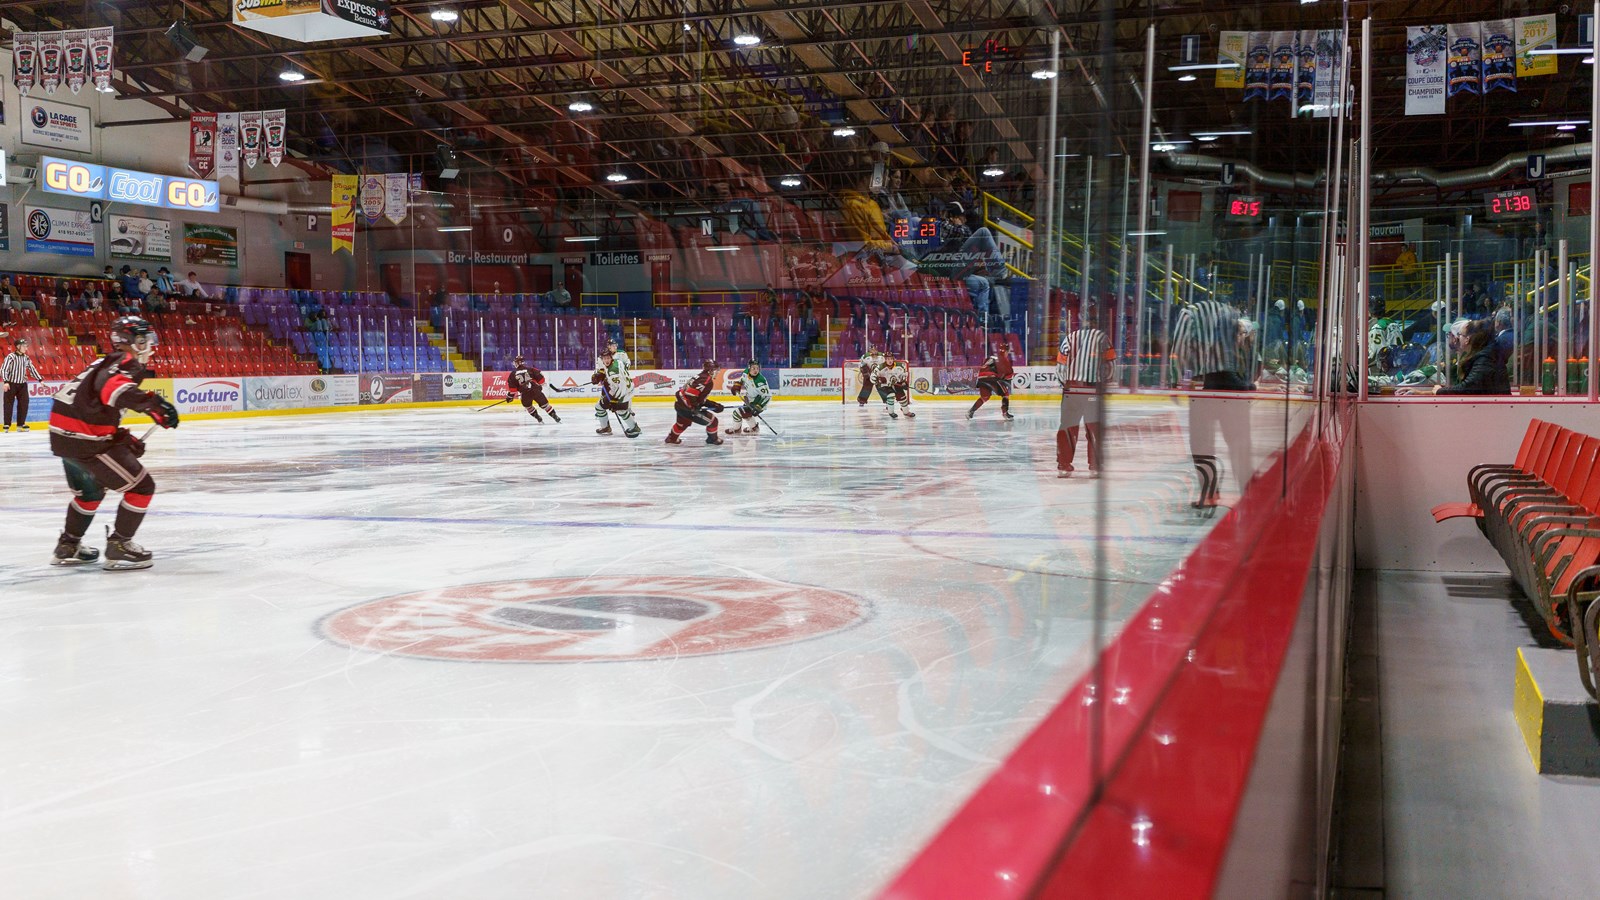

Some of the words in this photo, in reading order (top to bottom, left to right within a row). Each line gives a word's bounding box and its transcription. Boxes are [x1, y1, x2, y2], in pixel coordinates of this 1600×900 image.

[337, 0, 377, 17] Express
[354, 13, 377, 26] Beauce
[1524, 28, 1548, 38] 2017
[50, 112, 58, 120] LA
[60, 114, 77, 123] CAGE
[1530, 156, 1542, 178] J
[46, 162, 90, 193] GO
[109, 172, 162, 203] Cool
[168, 181, 206, 207] GO
[1492, 195, 1531, 213] 21:38
[91, 203, 102, 221] Q
[308, 216, 316, 229] P
[702, 220, 712, 235] N
[894, 225, 909, 238] 22
[920, 224, 936, 236] 23
[448, 251, 466, 263] Bar
[474, 251, 528, 263] Restaurant
[596, 253, 639, 265] Toilettes
[373, 379, 381, 396] 2
[492, 375, 506, 386] Tim
[790, 378, 829, 387] CENTRE
[916, 381, 928, 391] GO
[177, 389, 238, 404] Couture
[255, 385, 302, 400] duvaltex
[360, 392, 371, 400] DES
[486, 386, 509, 396] Horto
